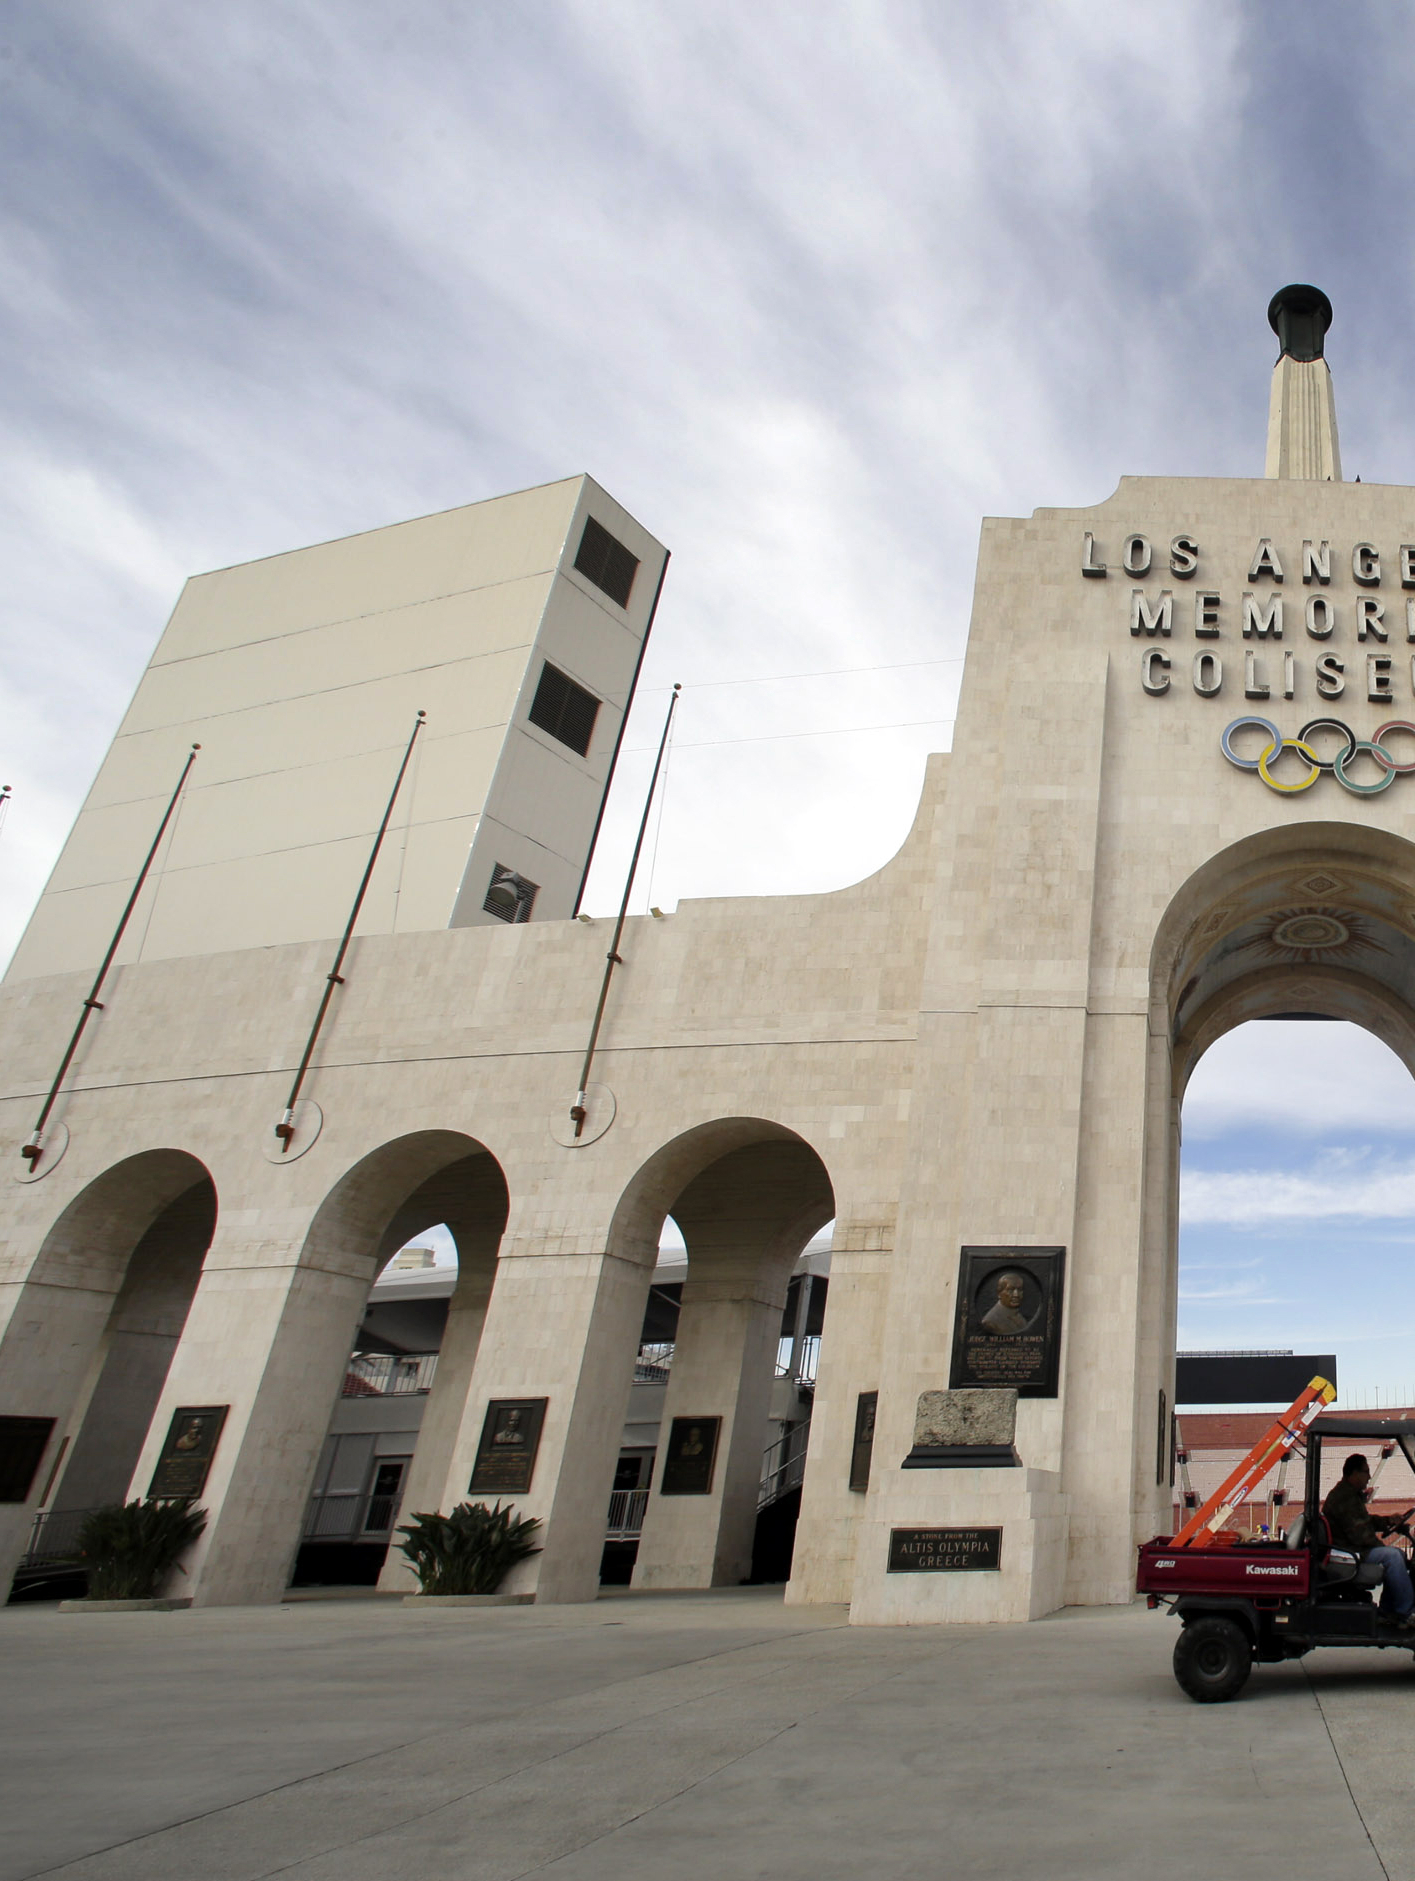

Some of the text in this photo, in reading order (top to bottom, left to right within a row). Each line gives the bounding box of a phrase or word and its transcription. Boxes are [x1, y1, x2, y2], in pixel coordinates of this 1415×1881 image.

[1082, 532, 1200, 580] LOS
[901, 1541, 990, 1553] ALTIS OLYMPIA
[919, 1555, 969, 1567] GREECE
[1246, 1564, 1299, 1576] Kawasaki
